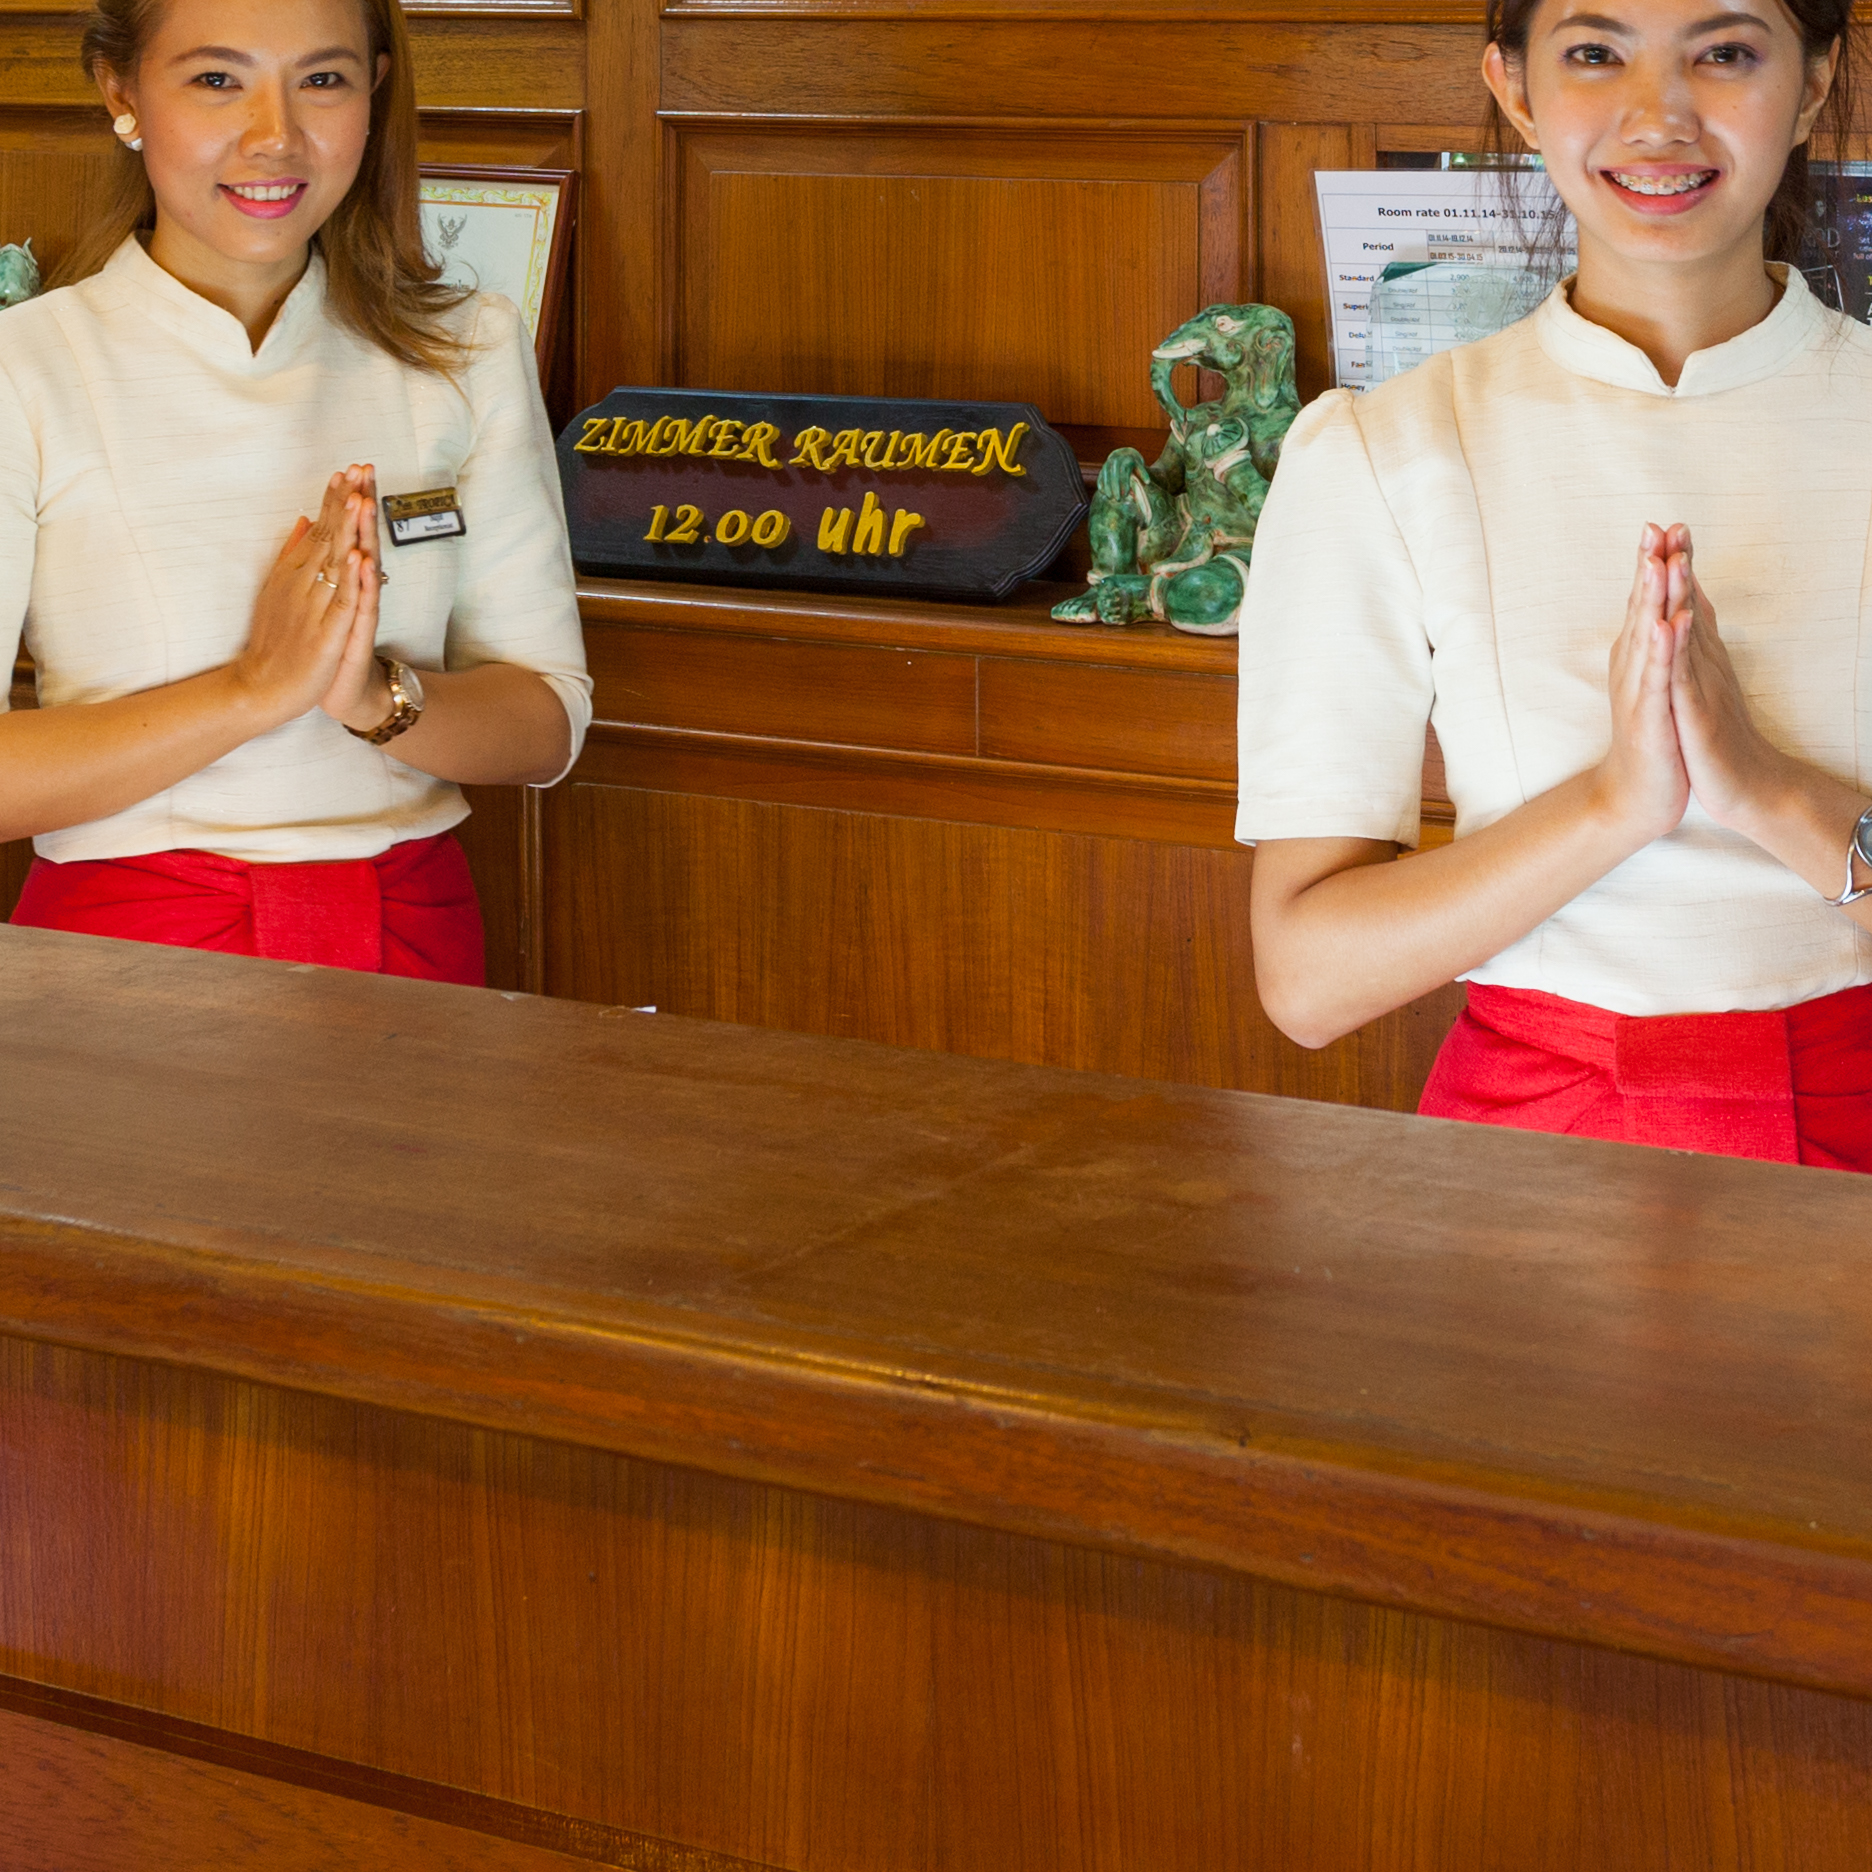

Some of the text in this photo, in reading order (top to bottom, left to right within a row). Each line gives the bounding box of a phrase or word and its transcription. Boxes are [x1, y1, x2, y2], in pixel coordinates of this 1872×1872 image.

[1856, 193, 1872, 204] Las
[1377, 206, 1412, 218] Room
[1416, 207, 1441, 218] rate
[1362, 241, 1394, 252] Period
[1343, 302, 1369, 311] Superi
[1348, 331, 1367, 339] Delu
[574, 414, 1029, 477] ZIMMER RAUMEN
[643, 491, 926, 558] 12.00 uhr
